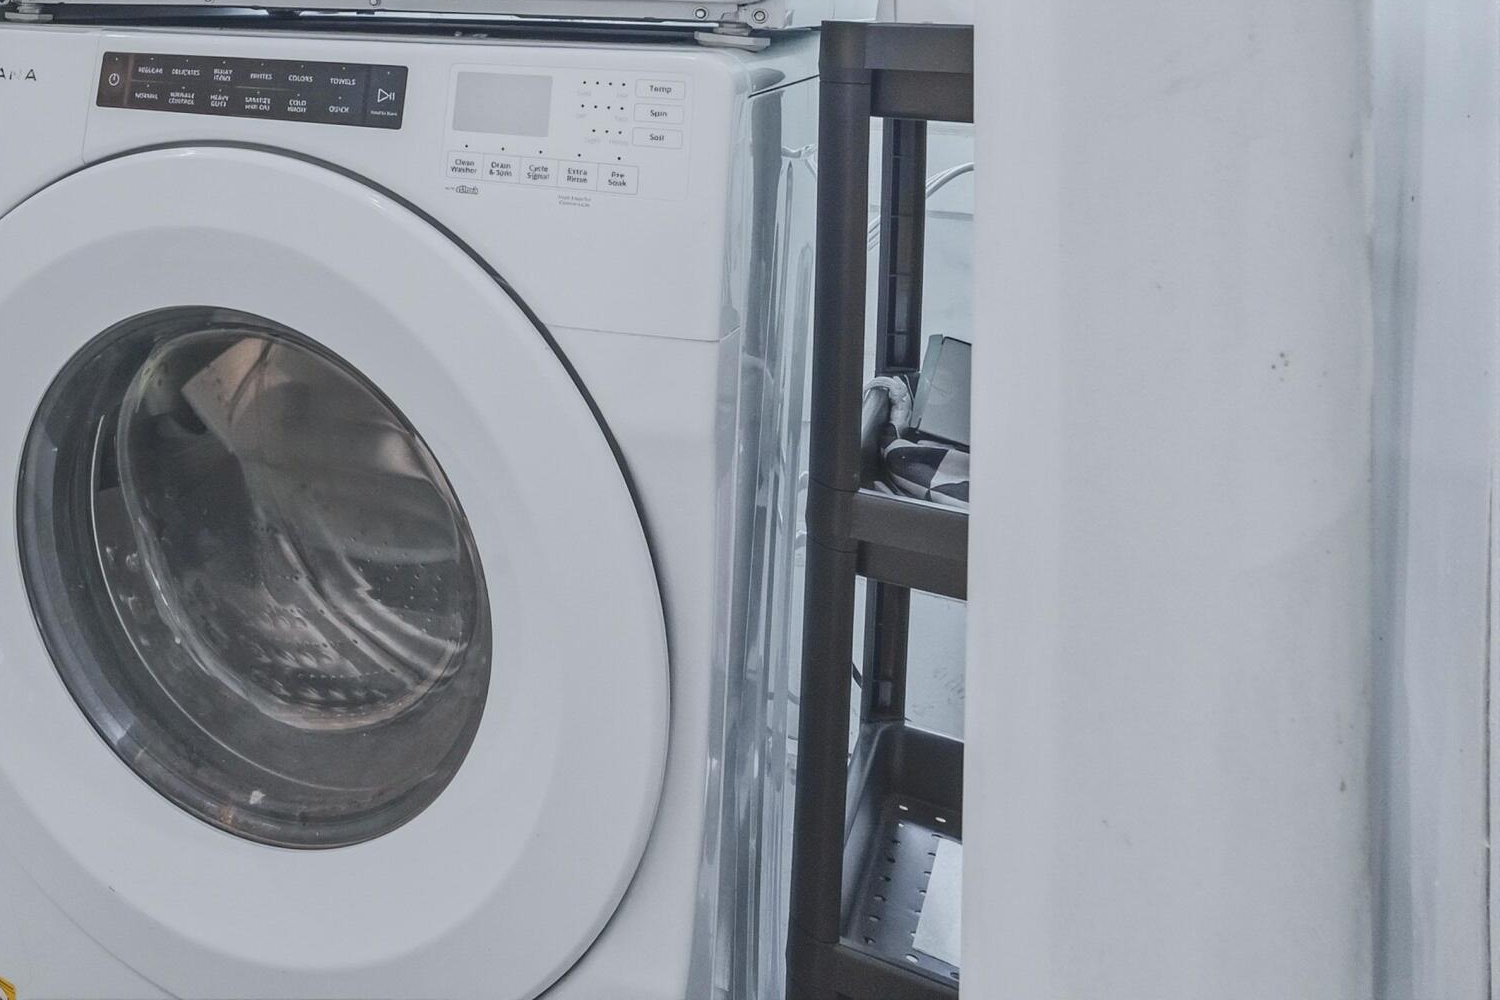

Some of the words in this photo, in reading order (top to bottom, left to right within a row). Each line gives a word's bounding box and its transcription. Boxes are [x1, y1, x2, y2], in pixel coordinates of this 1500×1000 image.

[288, 74, 314, 83] COLORS
[330, 77, 356, 85] TOWELS
[649, 85, 672, 94] Temp
[649, 109, 668, 117] Spin
[649, 133, 665, 141] Soil
[454, 158, 475, 166] Clean
[491, 161, 511, 169] Drain
[451, 166, 477, 174] Washer
[528, 164, 549, 172] Cycle
[567, 167, 588, 176] Extra
[526, 172, 550, 180] Signal
[608, 179, 626, 187] Soak
